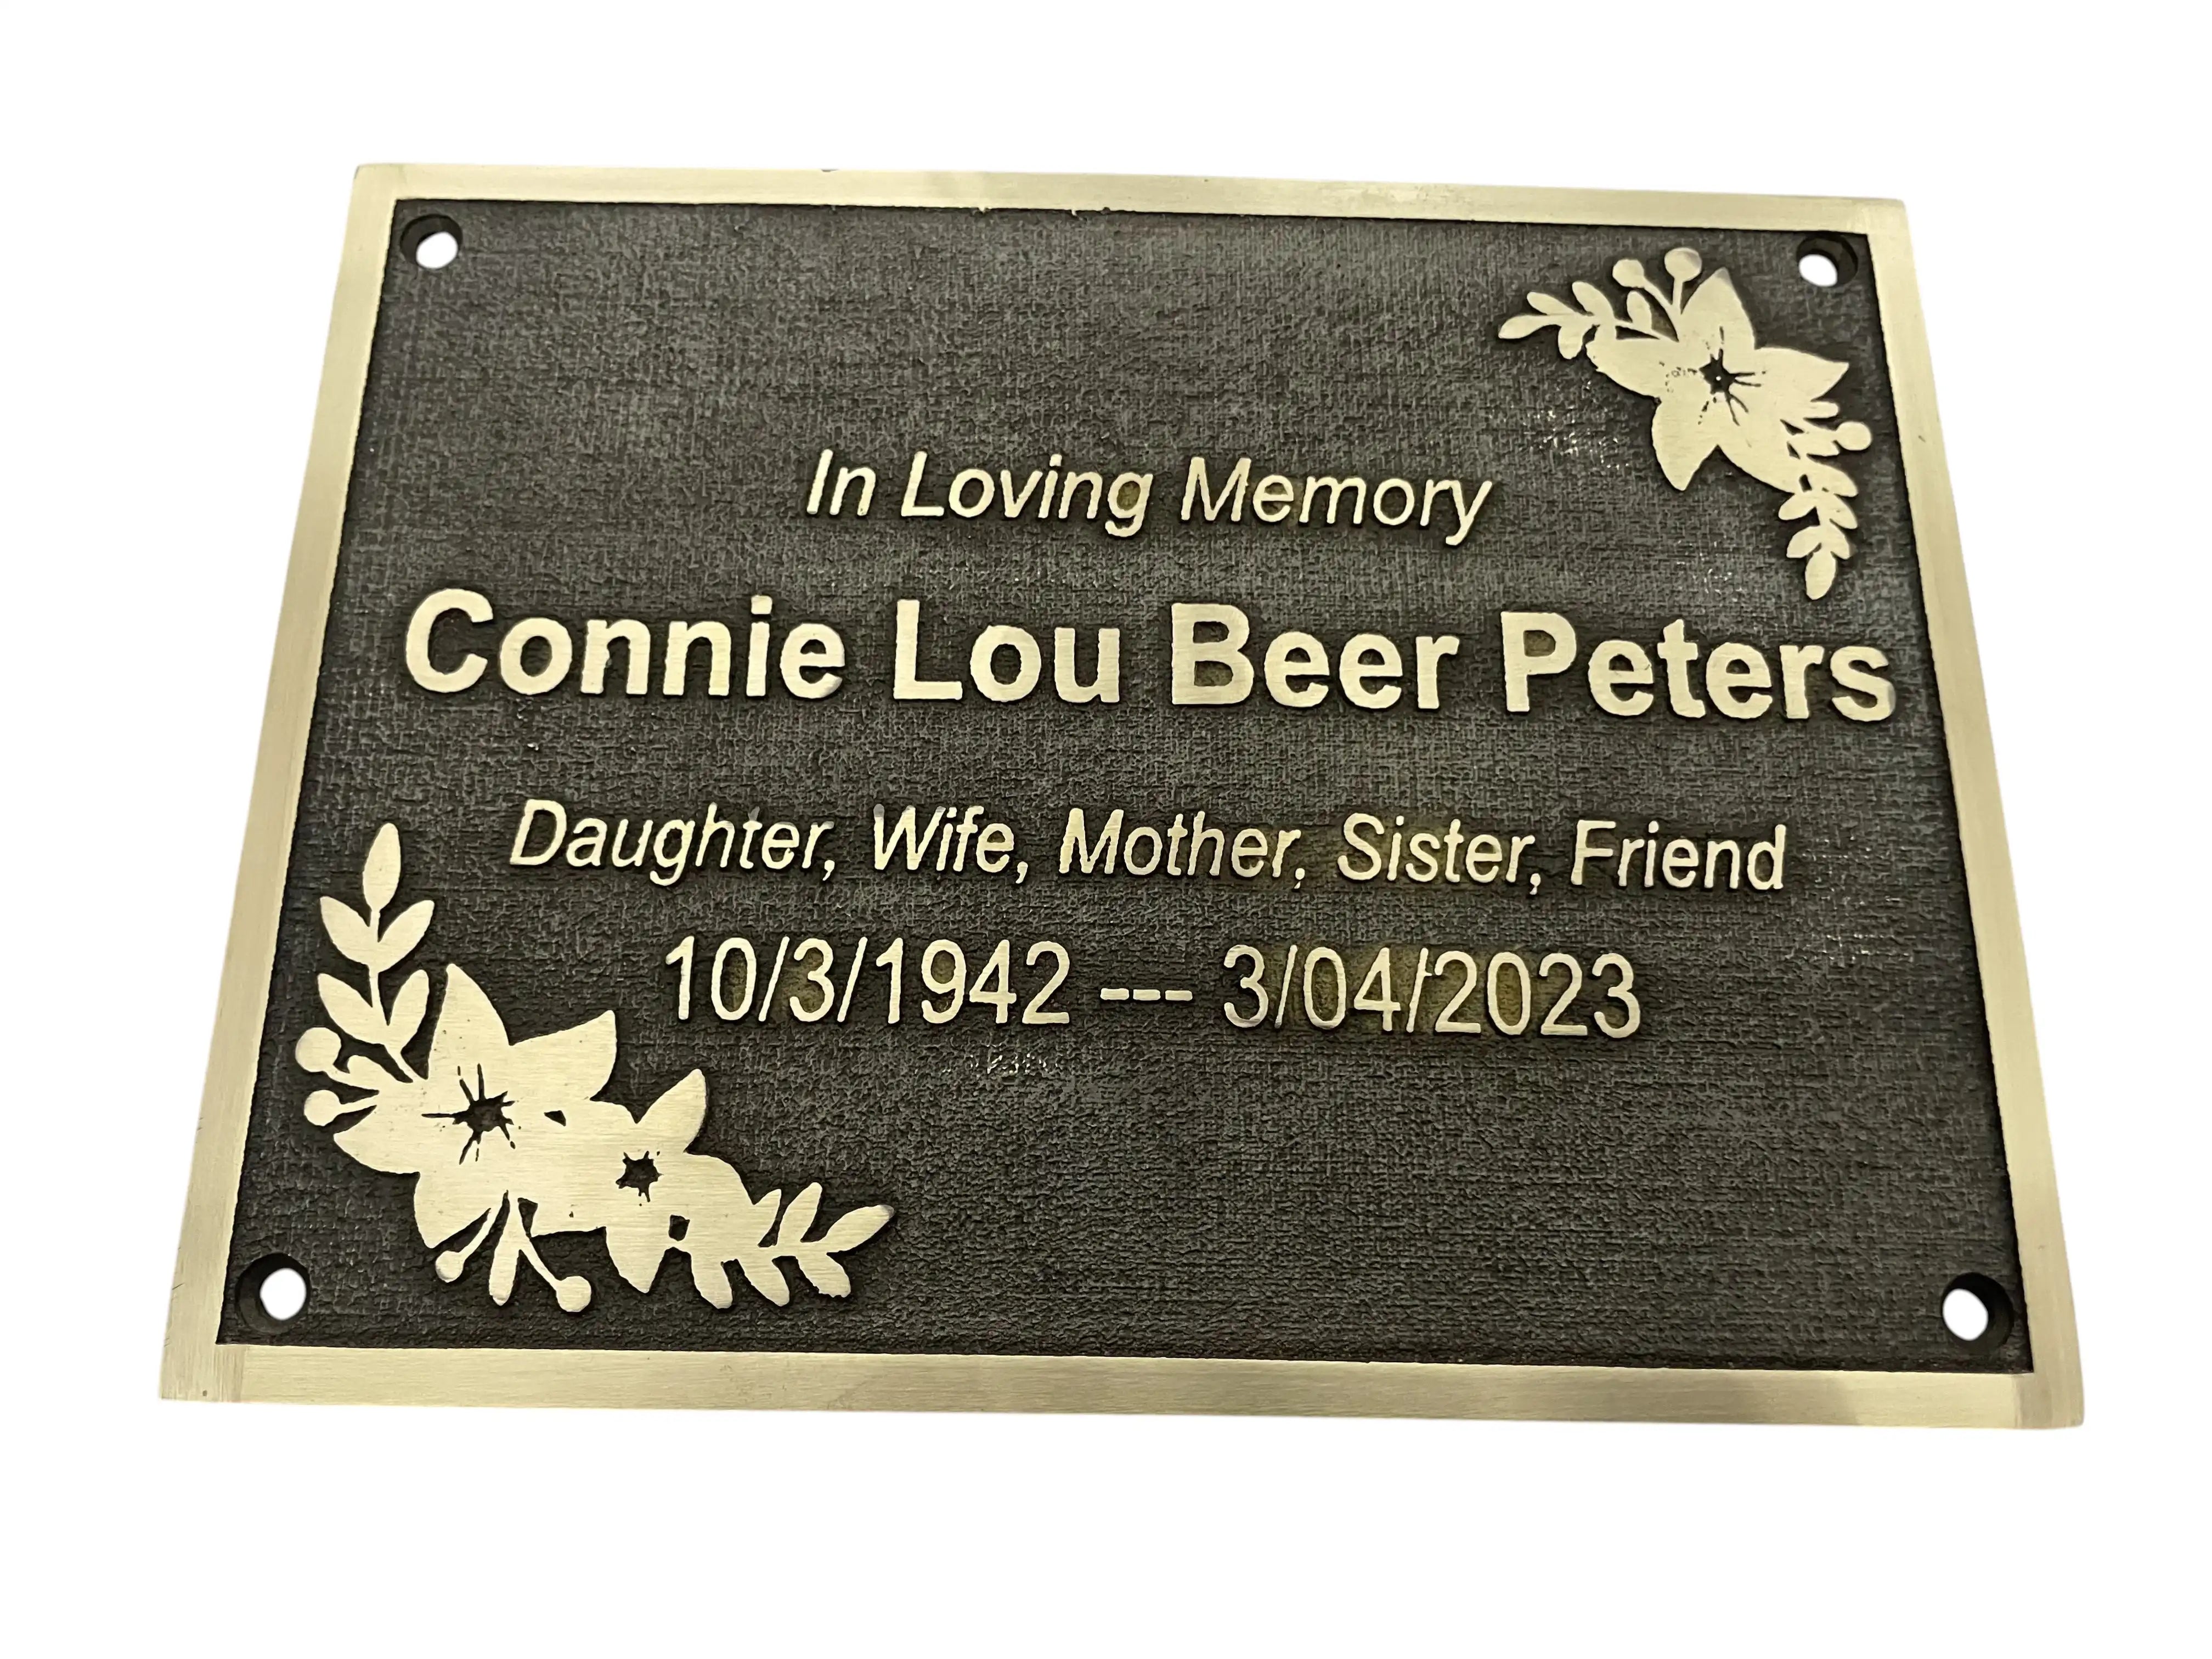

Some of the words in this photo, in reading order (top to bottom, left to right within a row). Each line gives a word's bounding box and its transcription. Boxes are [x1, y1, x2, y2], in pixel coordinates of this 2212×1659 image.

[807, 449, 877, 517] In
[901, 451, 1153, 537] Loving
[1181, 456, 1493, 545] Memory
[405, 589, 844, 698] Connie
[894, 599, 1121, 702] Lou
[1171, 603, 1459, 709] Beer
[1501, 611, 1894, 721] Peters
[510, 799, 834, 885] Daughter,
[874, 804, 1028, 883] Wife,
[1059, 808, 1306, 889] Mother,
[1338, 813, 1542, 894] Sister,
[1571, 820, 1787, 890] Friend
[666, 936, 1070, 1024] 10/3/1942
[1224, 945, 1640, 1037] 3/04/2023
